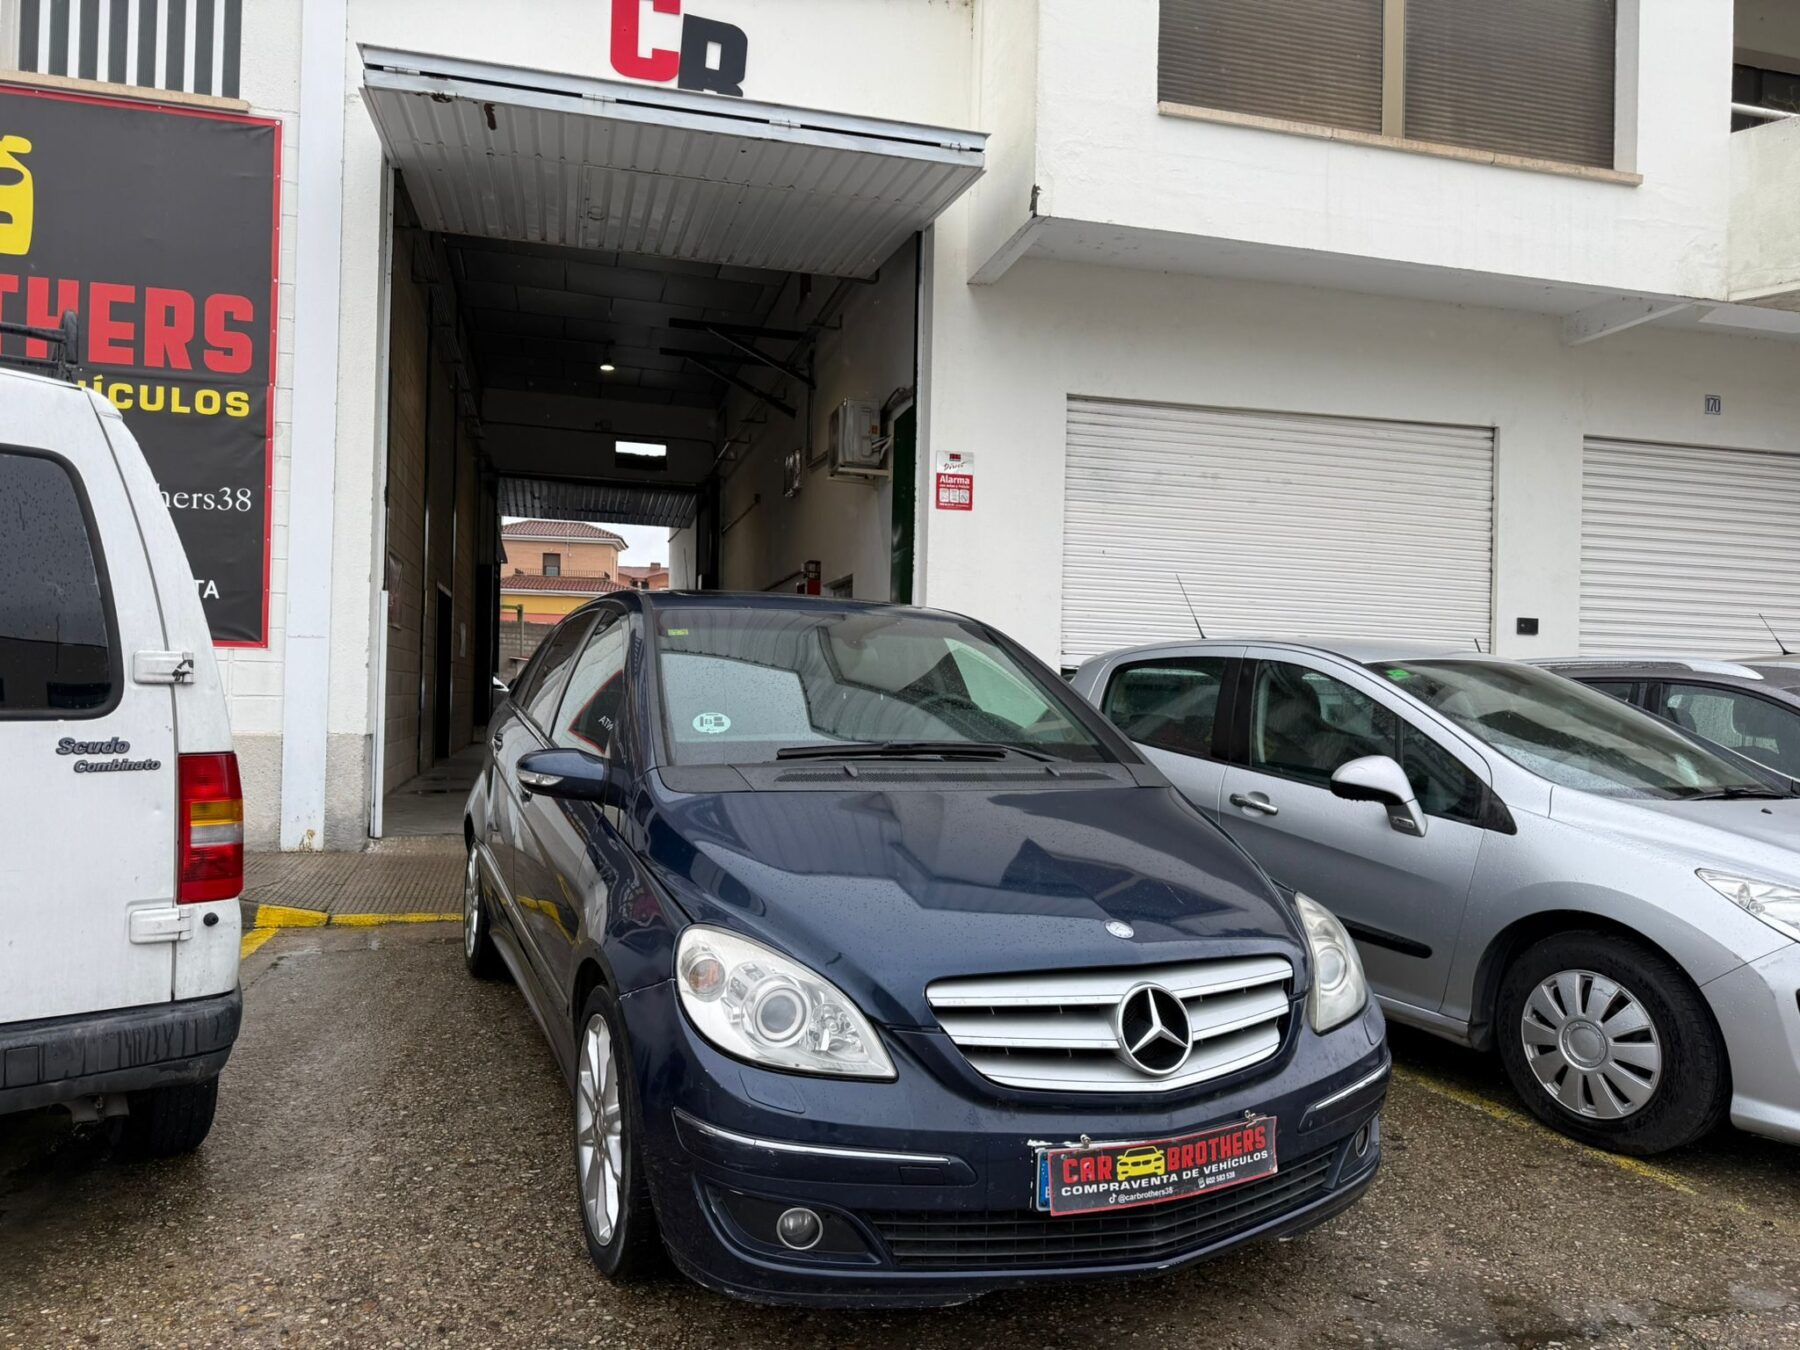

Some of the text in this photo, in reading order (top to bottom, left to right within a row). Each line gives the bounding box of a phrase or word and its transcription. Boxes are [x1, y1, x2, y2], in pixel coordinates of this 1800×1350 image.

[940, 475, 970, 485] Alarma
[56, 737, 130, 755] Scudo
[74, 759, 161, 773] Combinato
[1062, 1126, 1266, 1184] CAR BROTHERS
[1061, 1150, 1268, 1196] COMPRAVENTA DE VEHÍCULOS
[1118, 1186, 1173, 1203] @carbrothers38
